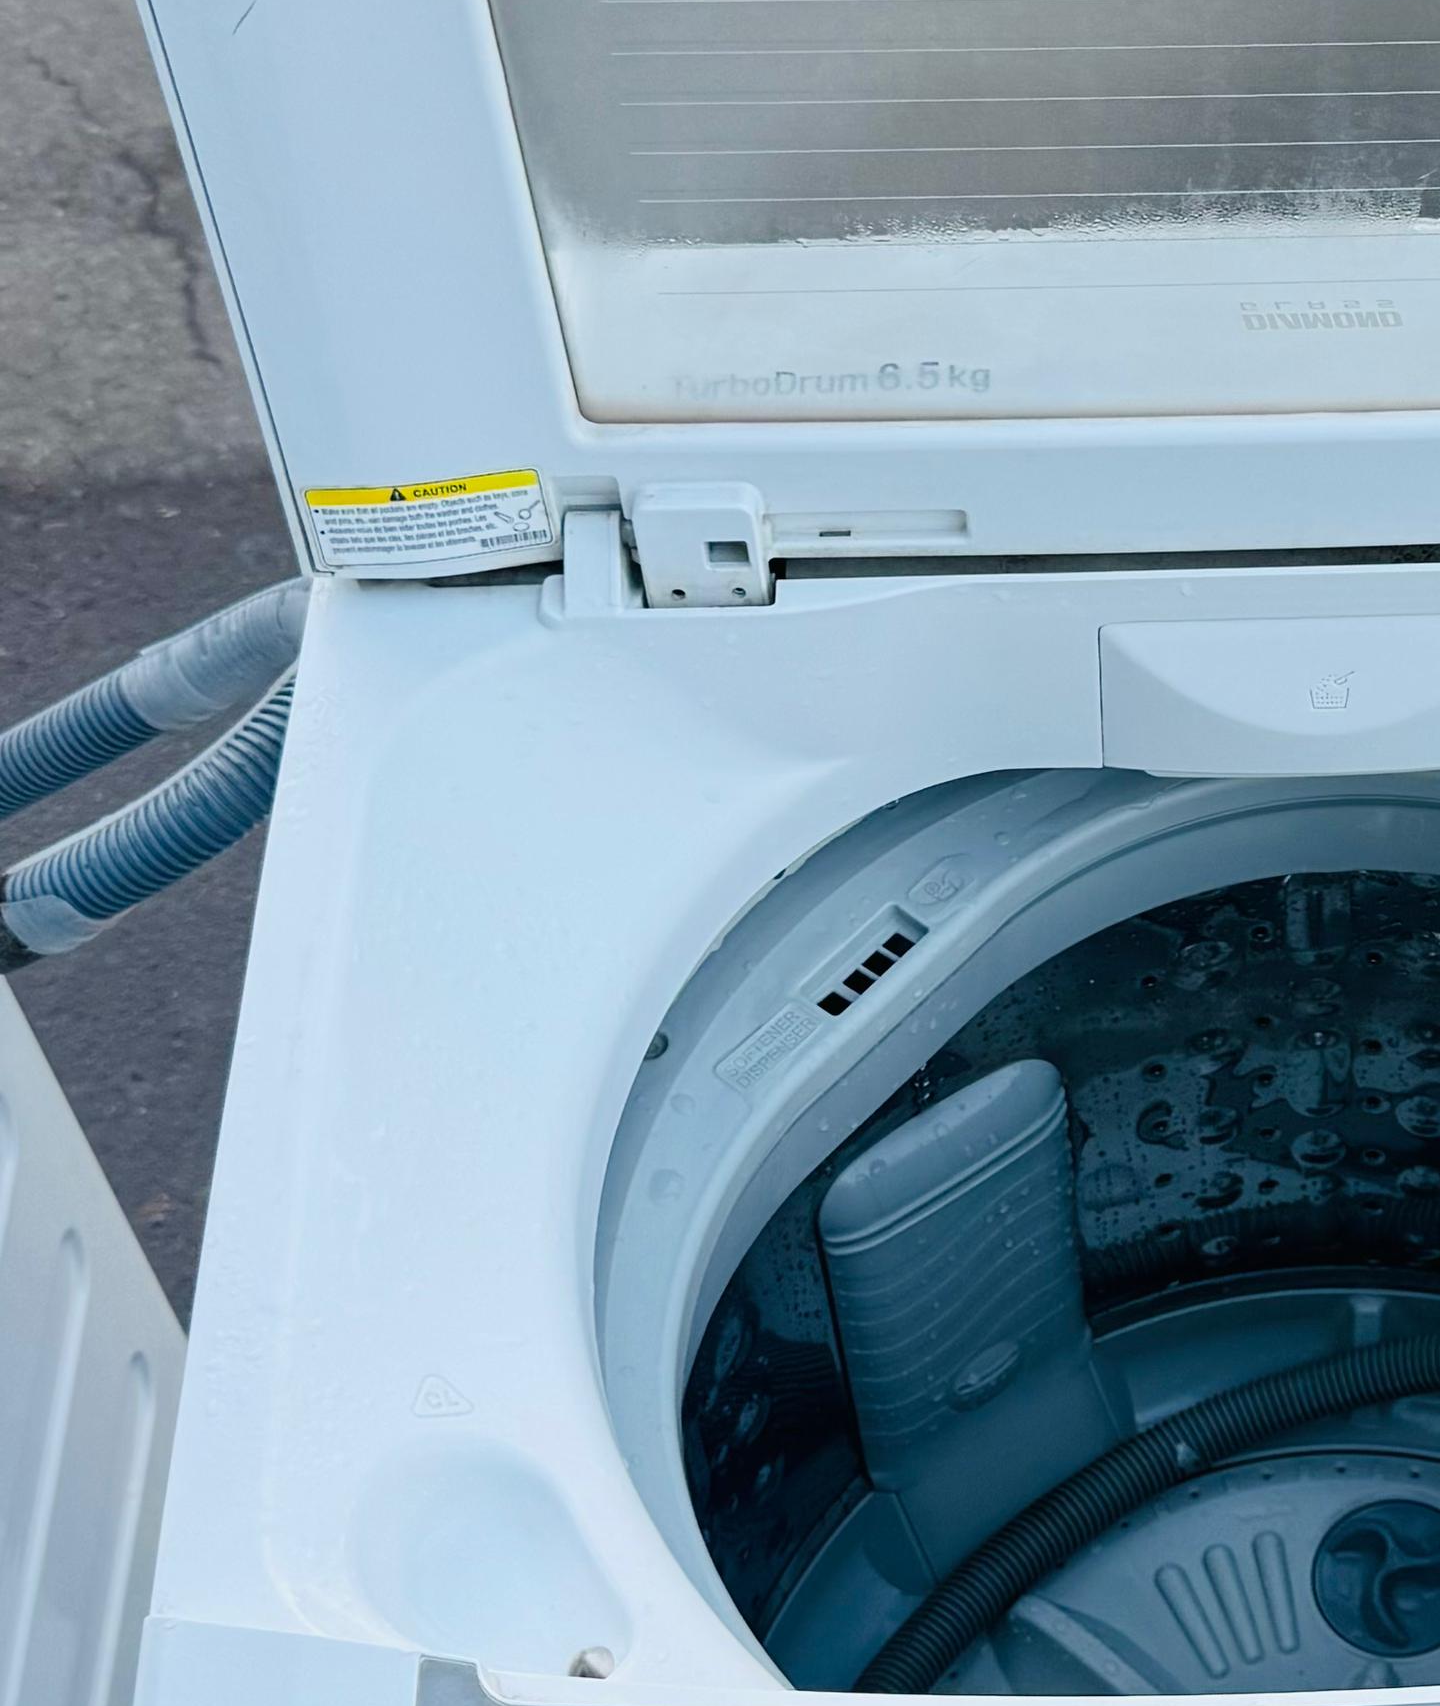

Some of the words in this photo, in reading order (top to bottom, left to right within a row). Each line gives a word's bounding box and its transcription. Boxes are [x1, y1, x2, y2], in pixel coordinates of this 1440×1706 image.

[672, 370, 868, 398] TurboDrum
[877, 360, 942, 391] 6.5
[948, 363, 991, 393] kg
[413, 483, 467, 498] CAUTION
